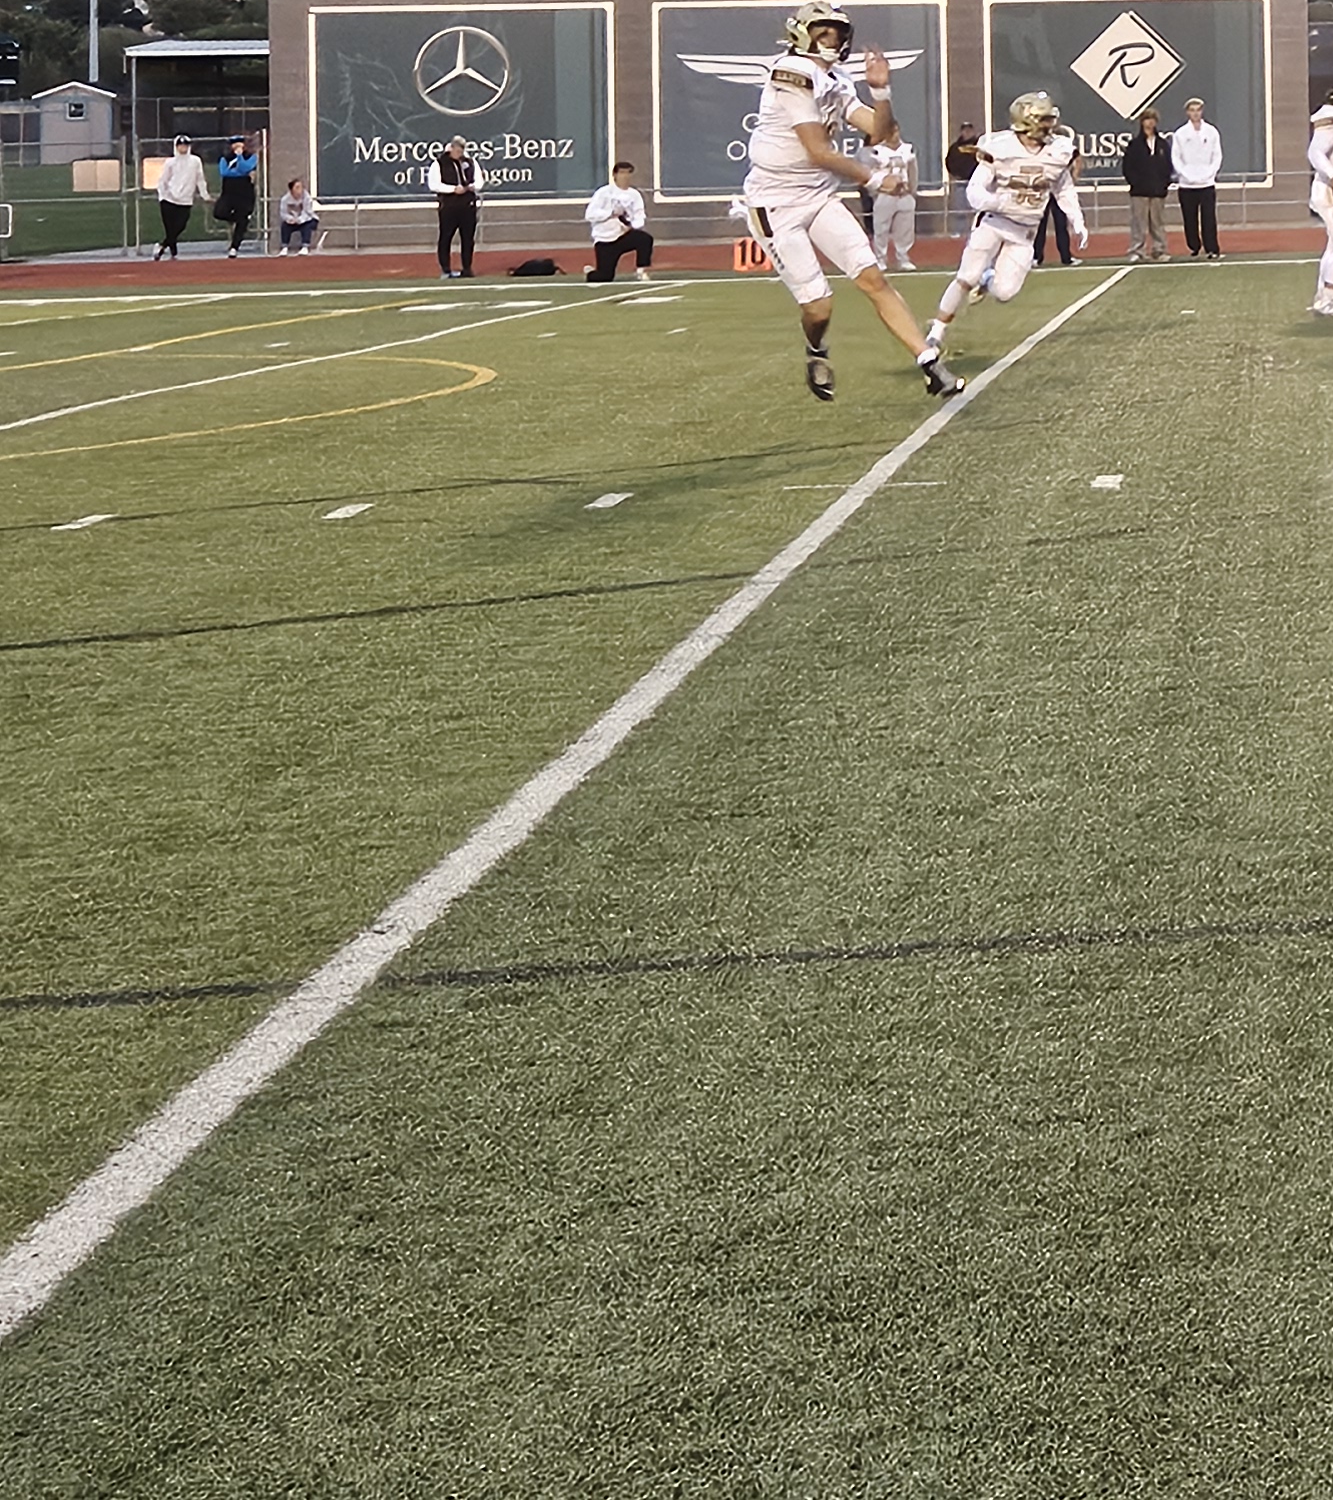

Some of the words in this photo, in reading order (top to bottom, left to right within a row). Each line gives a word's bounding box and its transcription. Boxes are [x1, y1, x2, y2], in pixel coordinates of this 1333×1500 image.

[1098, 41, 1155, 89] R
[353, 133, 574, 163] Mercees-Benz
[1052, 125, 1174, 157] uss
[394, 167, 414, 185] of
[420, 167, 533, 186] Fgton
[739, 240, 767, 266] 10
